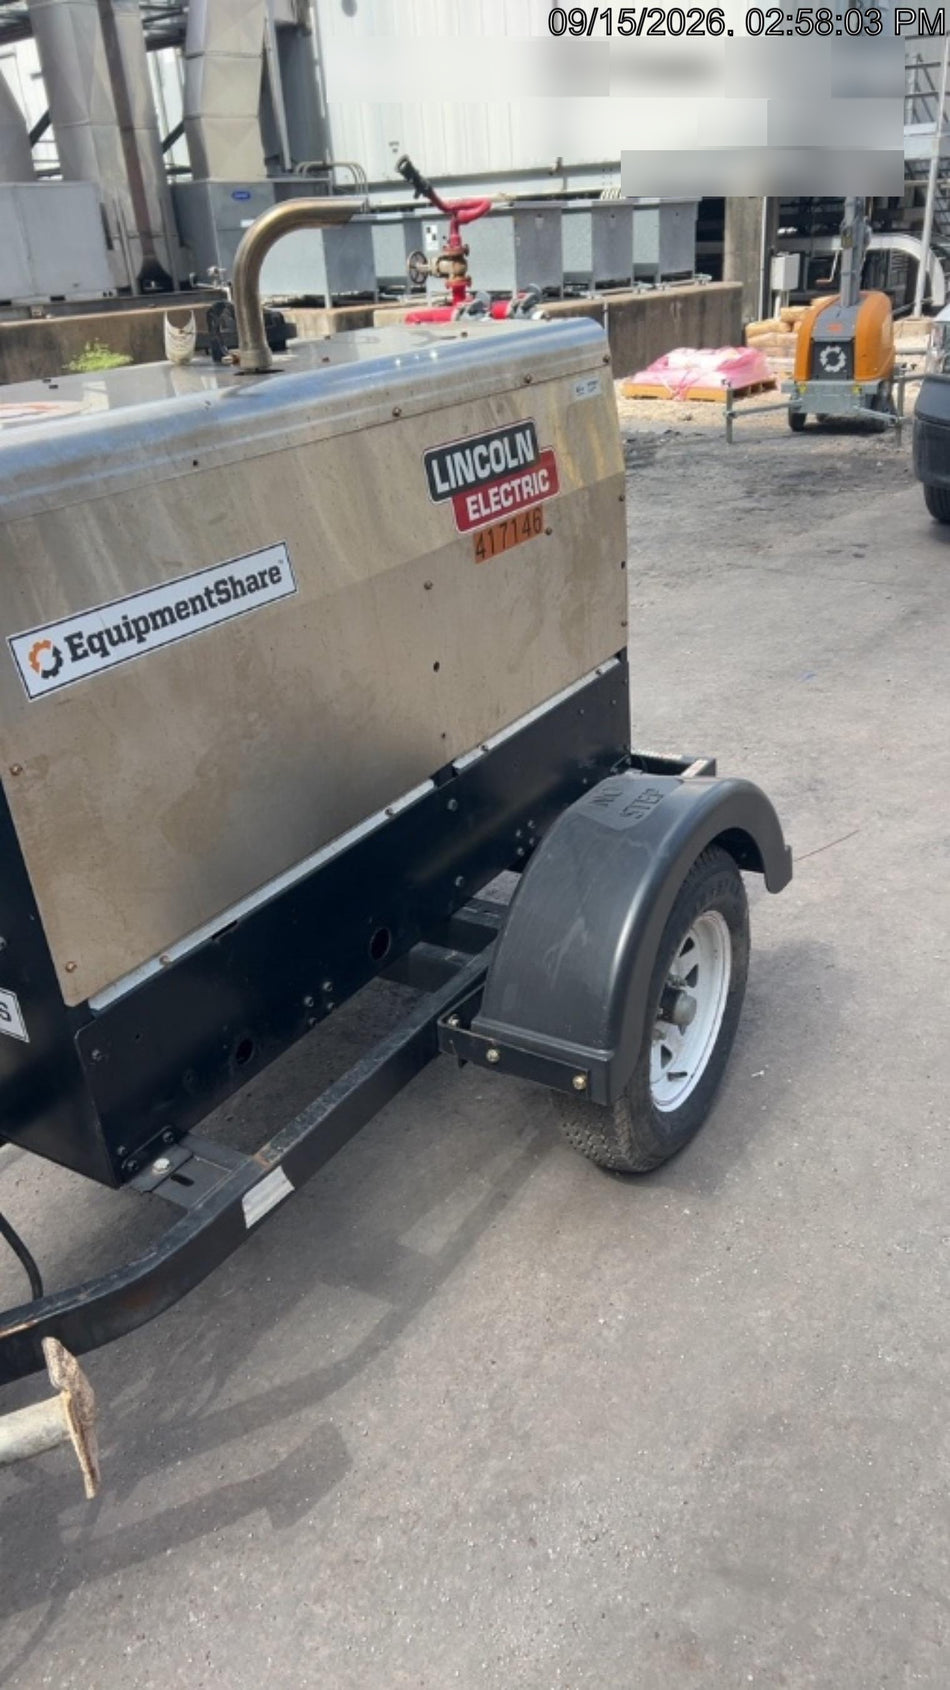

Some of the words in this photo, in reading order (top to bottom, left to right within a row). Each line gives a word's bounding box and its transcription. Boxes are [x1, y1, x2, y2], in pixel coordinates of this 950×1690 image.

[431, 429, 535, 494] LINCOLN
[465, 468, 551, 521] ELECTRIC
[474, 506, 543, 559] 417146
[64, 564, 283, 663] EquipmentShare
[619, 788, 664, 820] STEP
